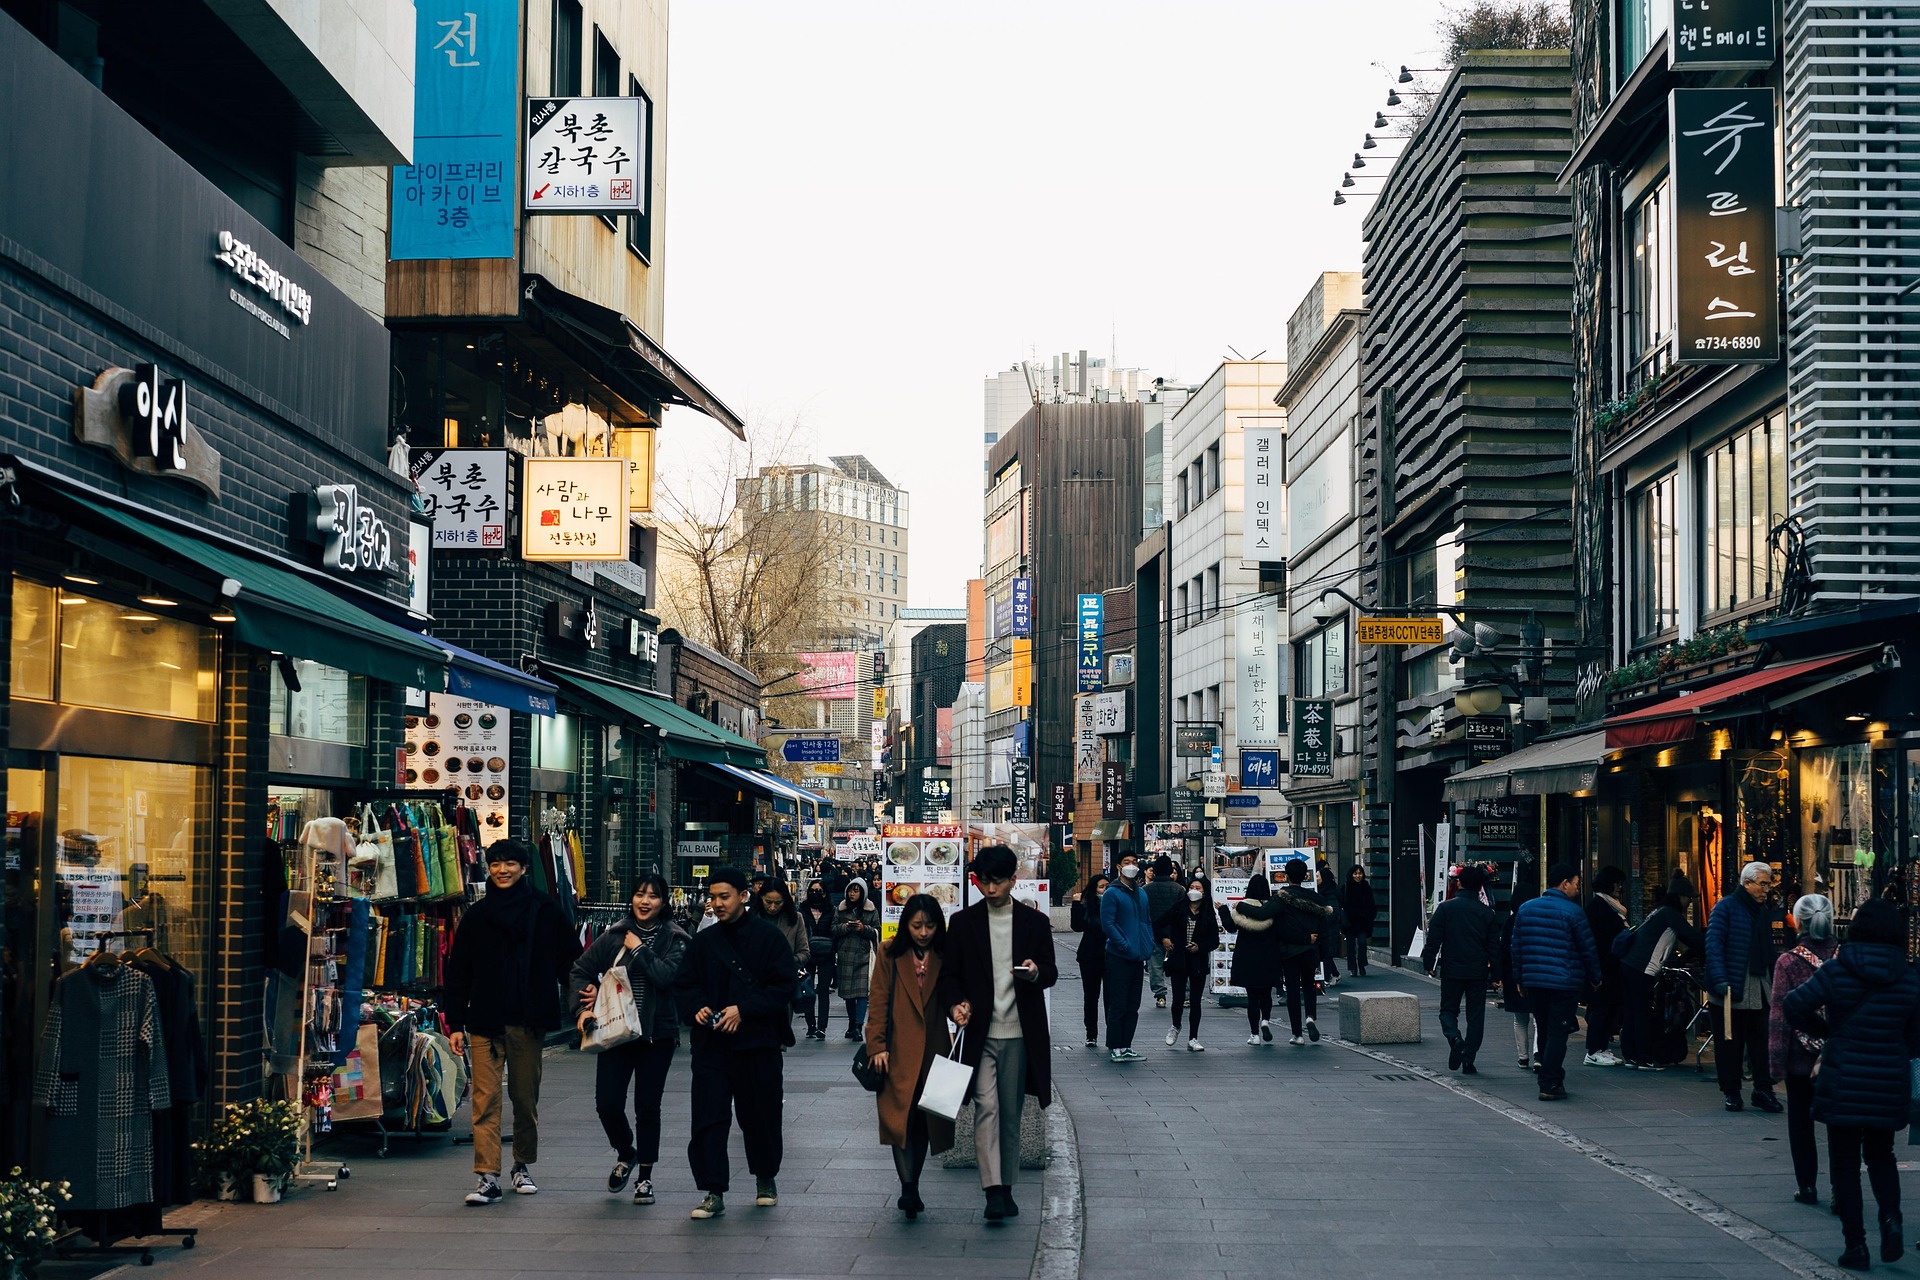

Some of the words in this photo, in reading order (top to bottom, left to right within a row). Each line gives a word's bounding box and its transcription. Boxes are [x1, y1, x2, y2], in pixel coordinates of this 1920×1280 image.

[434, 12, 480, 67] 전
[1680, 24, 1766, 51] 핸드메이드
[531, 101, 557, 126] 인사동
[555, 113, 614, 143] 북촌
[405, 161, 503, 185] 라이프러리
[537, 146, 631, 176] 칼국수
[406, 185, 502, 206] 아카이브
[553, 184, 600, 199] 지하1층
[437, 206, 470, 228] 3층
[1706, 336, 1761, 350] 734-6890
[1256, 438, 1270, 487] 갤러리
[431, 462, 487, 491] 북촌
[572, 506, 613, 523] 나무
[1256, 501, 1270, 548] 인덱스
[435, 530, 479, 543] 지하1층
[1015, 580, 1028, 626] 세종화랑
[1248, 664, 1266, 692] 반한
[1252, 698, 1267, 732] 찻집
[1297, 751, 1328, 763] 다암
[1015, 777, 1027, 806] 칼국수
[1055, 786, 1065, 820] 한양화랑
[1107, 768, 1115, 812] 국제자수원
[924, 825, 963, 837] 북촌칼국수
[678, 844, 693, 853] TAL
[695, 844, 719, 853] BANG
[893, 866, 914, 874] 칼국수
[1215, 886, 1241, 894] 47번가
